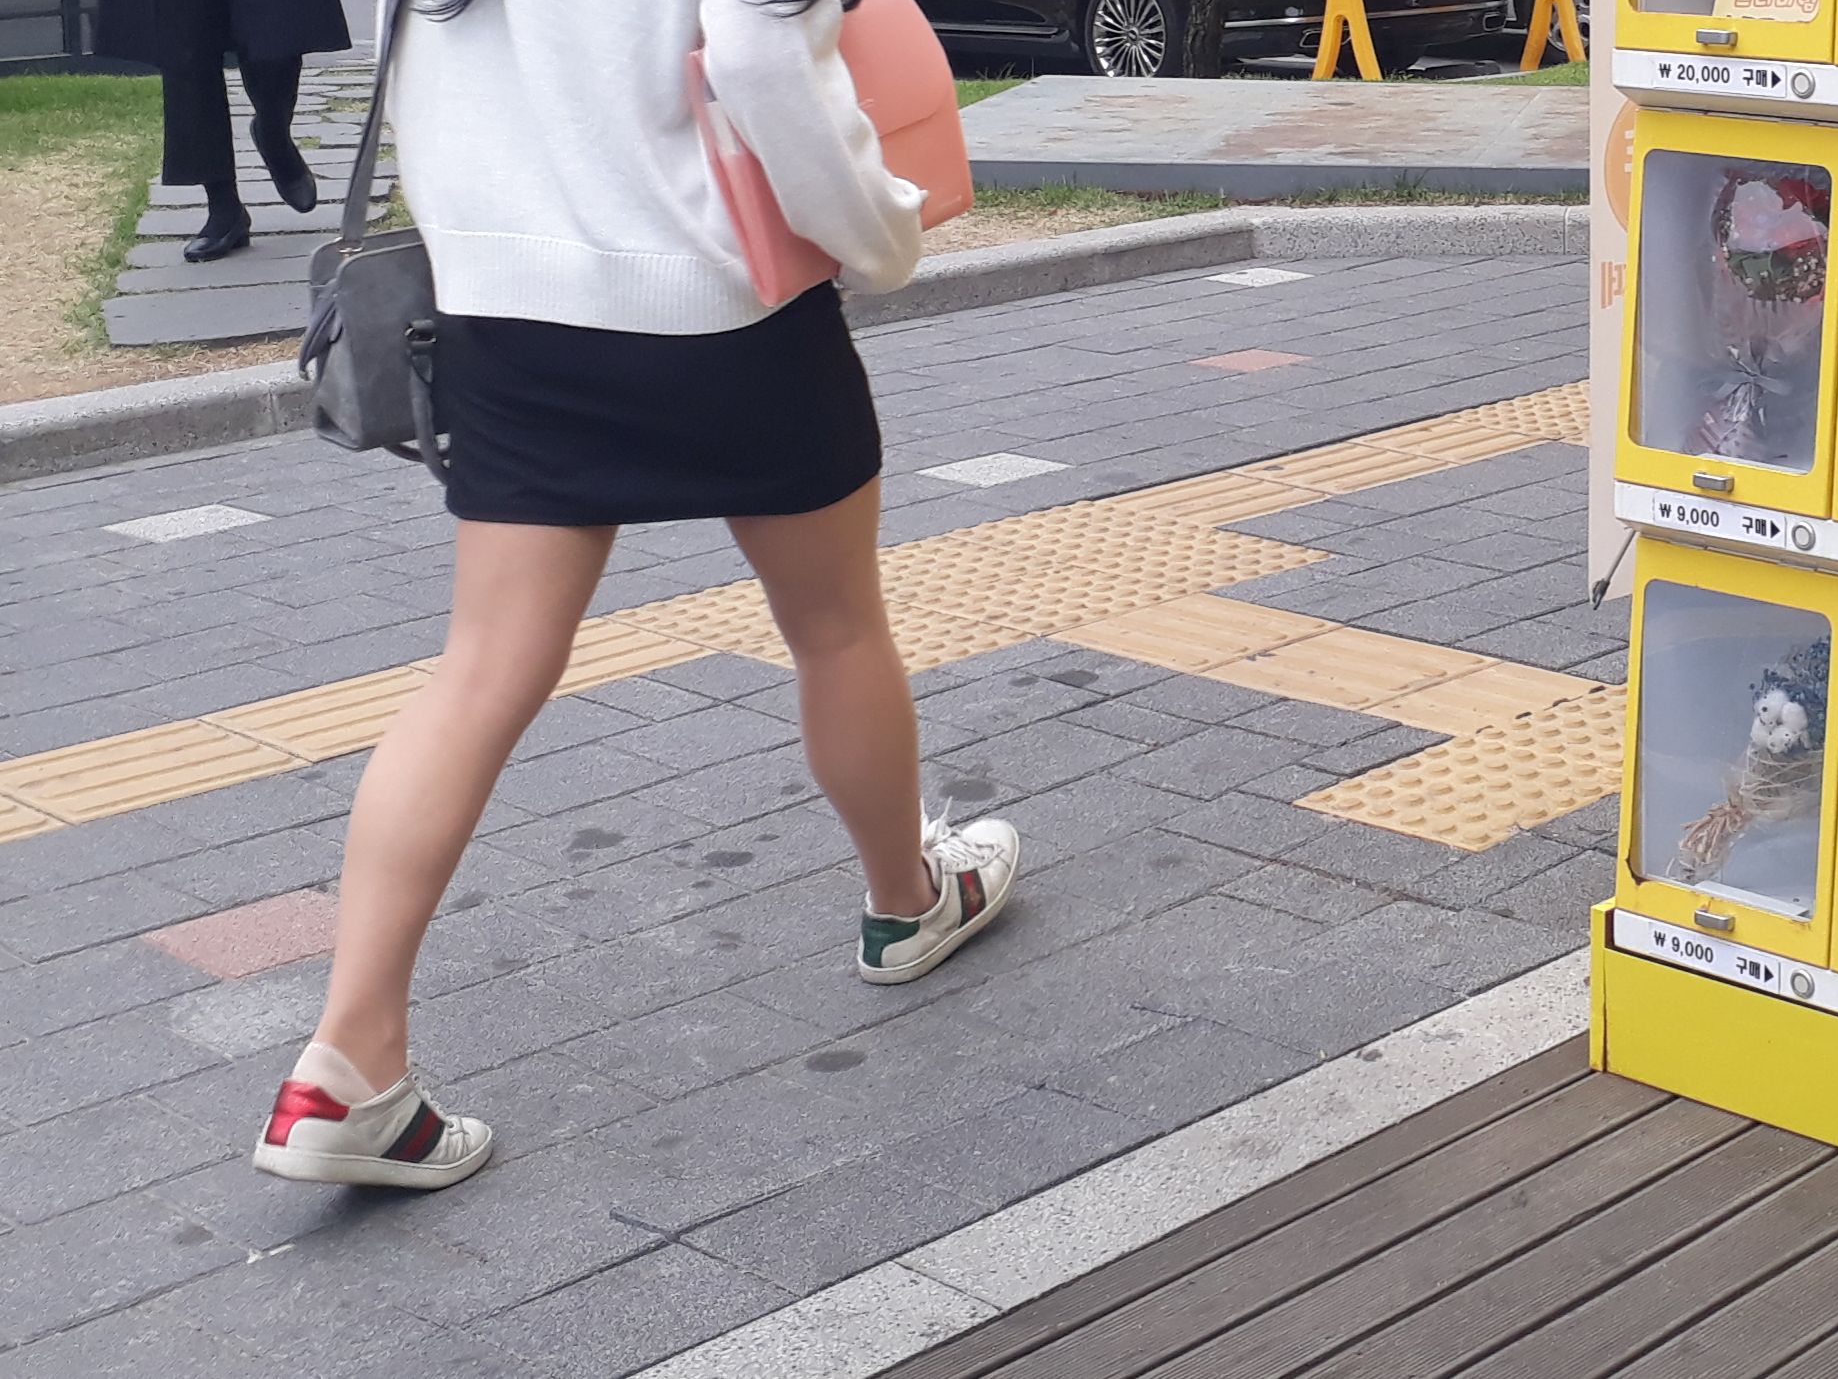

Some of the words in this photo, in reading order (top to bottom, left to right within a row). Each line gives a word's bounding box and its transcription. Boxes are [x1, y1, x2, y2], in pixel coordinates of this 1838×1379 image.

[1658, 64, 1672, 79] ₩
[1676, 63, 1730, 86] 20,000
[1742, 68, 1768, 88] 구매
[1659, 503, 1673, 518] ₩
[1676, 506, 1720, 527] 9,000
[1741, 516, 1767, 538] 구매
[1653, 930, 1667, 946] ₩
[1671, 935, 1714, 963] 9,000
[1736, 956, 1761, 980] 구매
